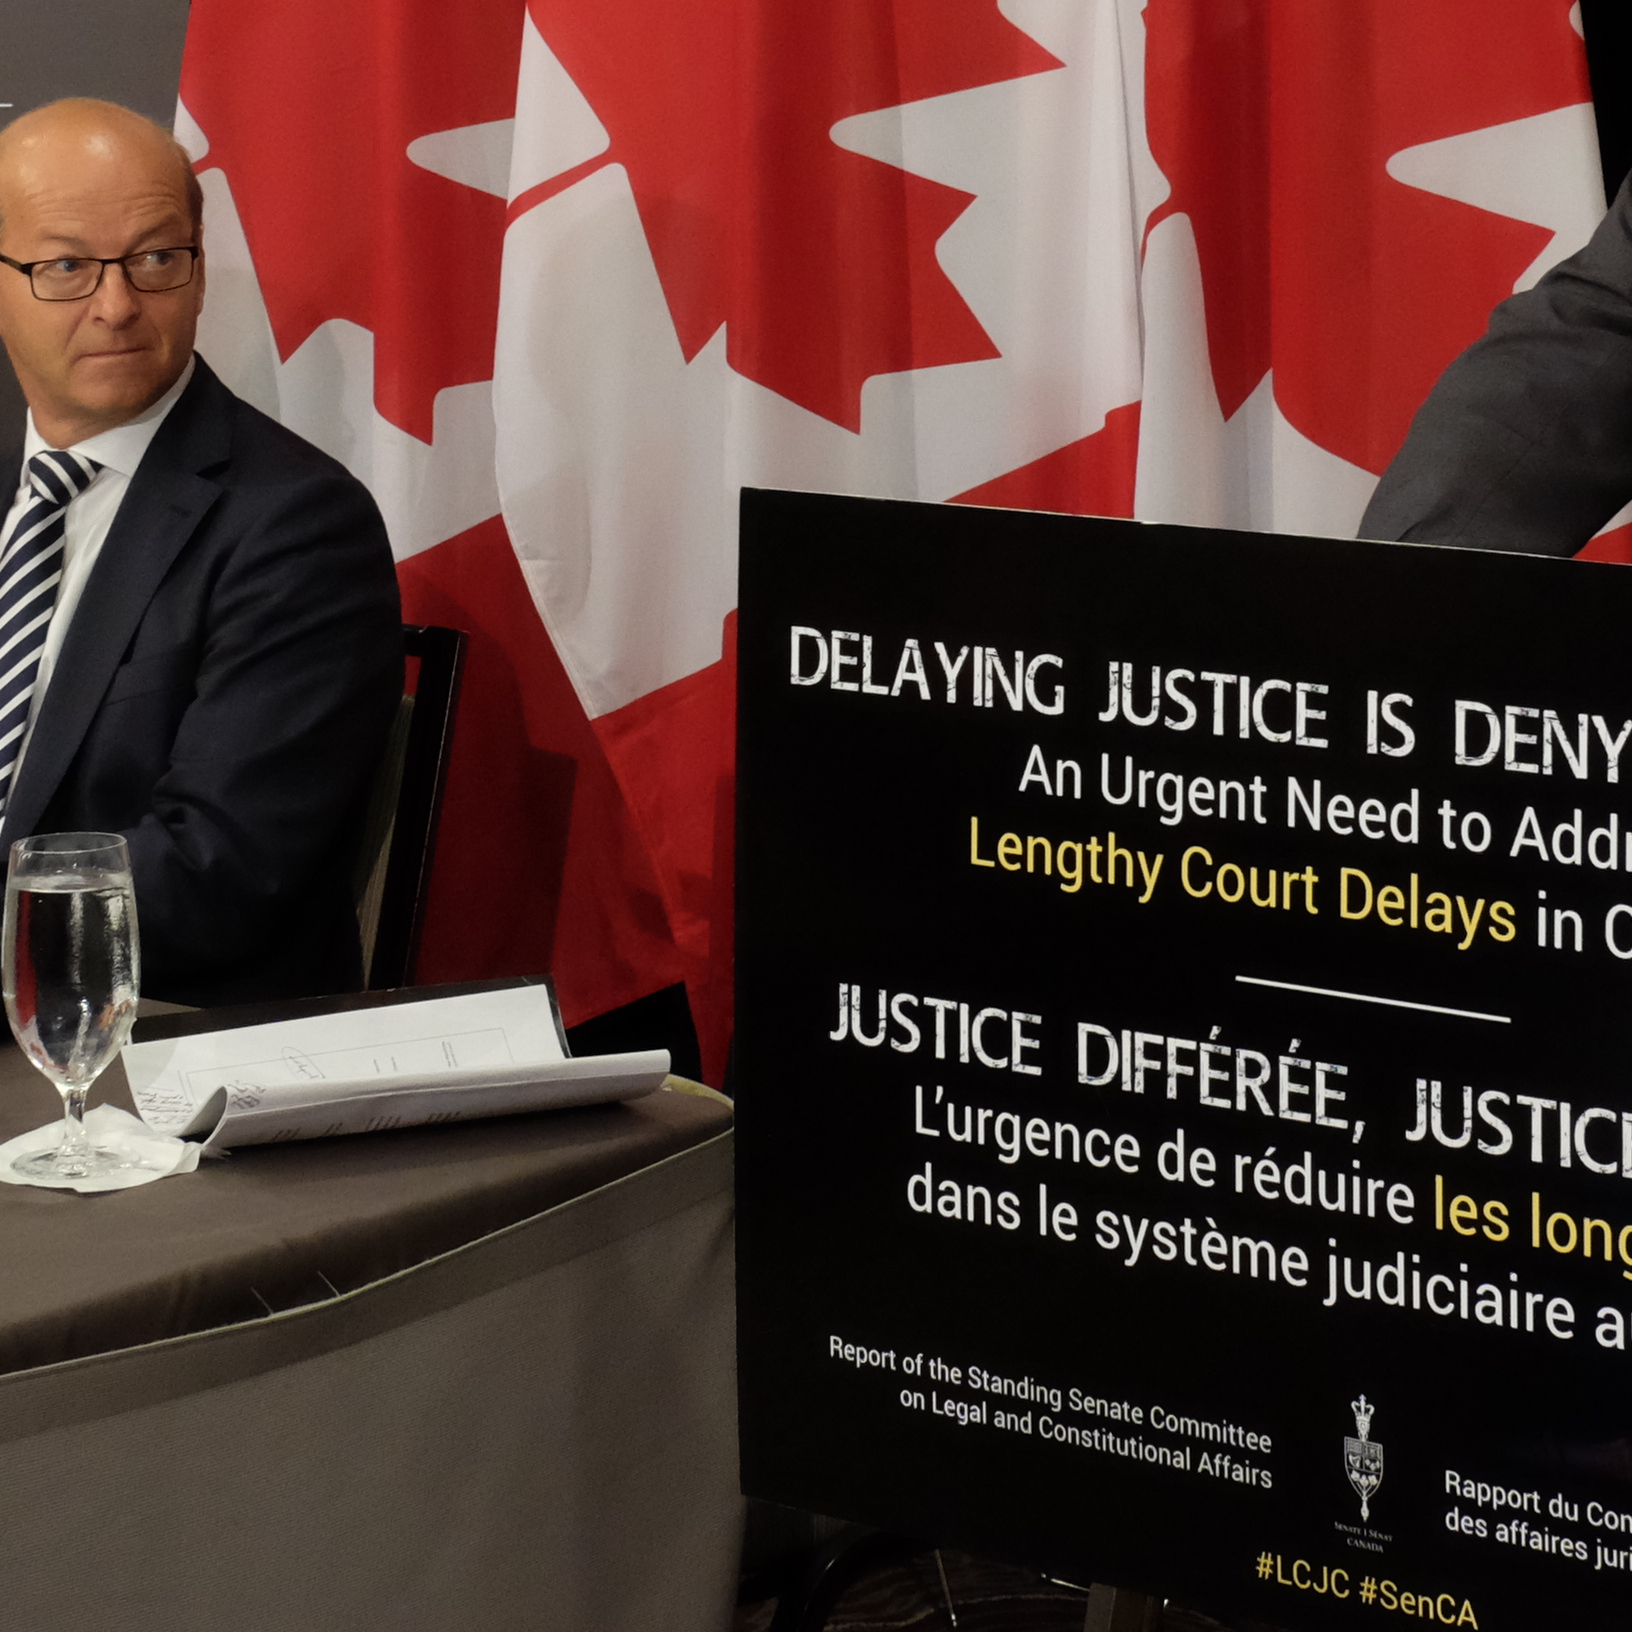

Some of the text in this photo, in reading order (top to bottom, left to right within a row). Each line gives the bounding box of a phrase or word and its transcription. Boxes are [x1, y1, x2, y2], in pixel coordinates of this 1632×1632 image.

[789, 624, 1066, 717] DELAYING
[1097, 660, 1330, 750] JUSTICE
[1365, 688, 1417, 759] IS
[1017, 743, 1083, 801] An
[1100, 751, 1268, 826] Urgent
[1286, 775, 1420, 845] Need
[1436, 798, 1493, 854] to
[969, 815, 1165, 905] Lengthy
[1180, 844, 1320, 916] Court
[1339, 865, 1517, 952] Delays
[1536, 888, 1584, 953] in
[828, 982, 1043, 1077] JUSTICE
[1076, 1021, 1366, 1144] DIFFÉRÉE,
[914, 1084, 1141, 1174] L'urgence
[1156, 1127, 1217, 1188] de
[1234, 1145, 1416, 1225] réduire
[1434, 1173, 1511, 1243] les
[906, 1161, 1022, 1231] dans
[1038, 1182, 1079, 1242] le
[1094, 1209, 1310, 1288] système
[1321, 1236, 1576, 1340] judiciaire
[829, 1335, 1272, 1453] Report of the Standing Senate Committee
[899, 1389, 1273, 1489] on Legal and Constitutional Affairs
[1445, 1470, 1541, 1513] Rapport
[1548, 1493, 1578, 1522] du
[1445, 1506, 1488, 1537] des
[1495, 1520, 1588, 1560] affaires
[1255, 1551, 1479, 1631] #LCJC #SenCA
